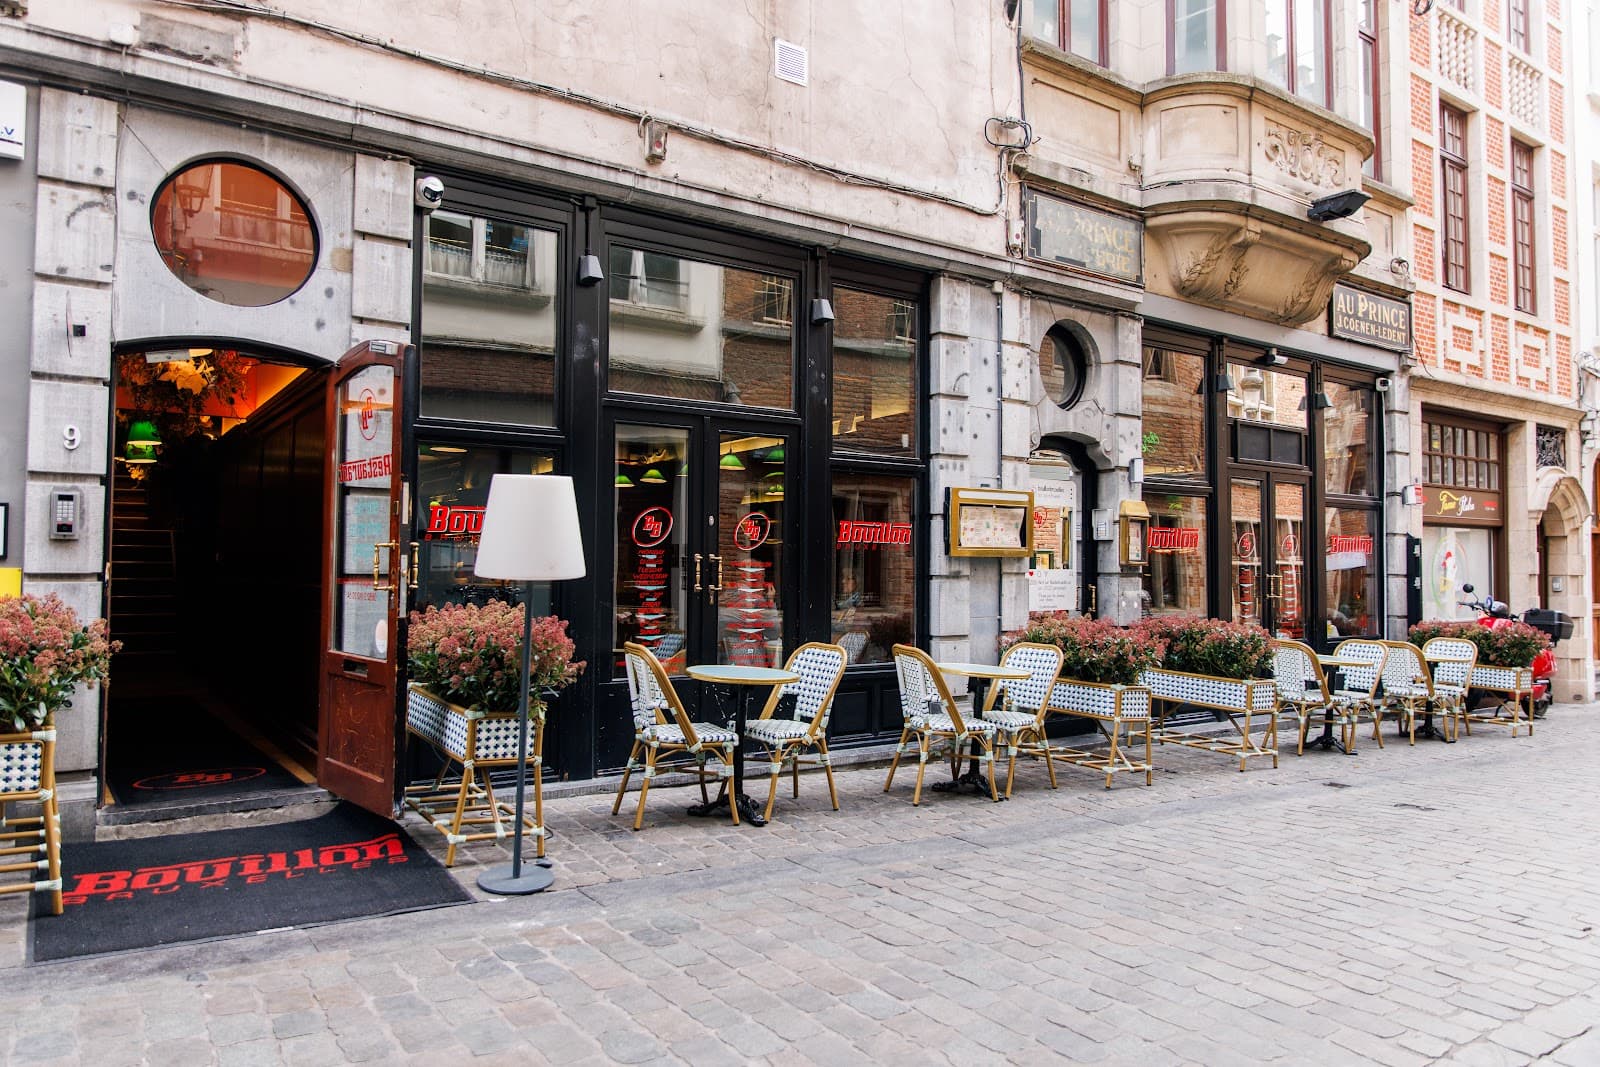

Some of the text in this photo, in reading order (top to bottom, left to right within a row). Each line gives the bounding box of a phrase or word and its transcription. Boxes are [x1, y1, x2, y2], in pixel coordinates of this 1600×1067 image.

[1337, 292, 1406, 330] AU PRINCE
[63, 424, 80, 450] 9
[837, 520, 912, 544] Bouillon
[62, 833, 403, 896] Bouillon
